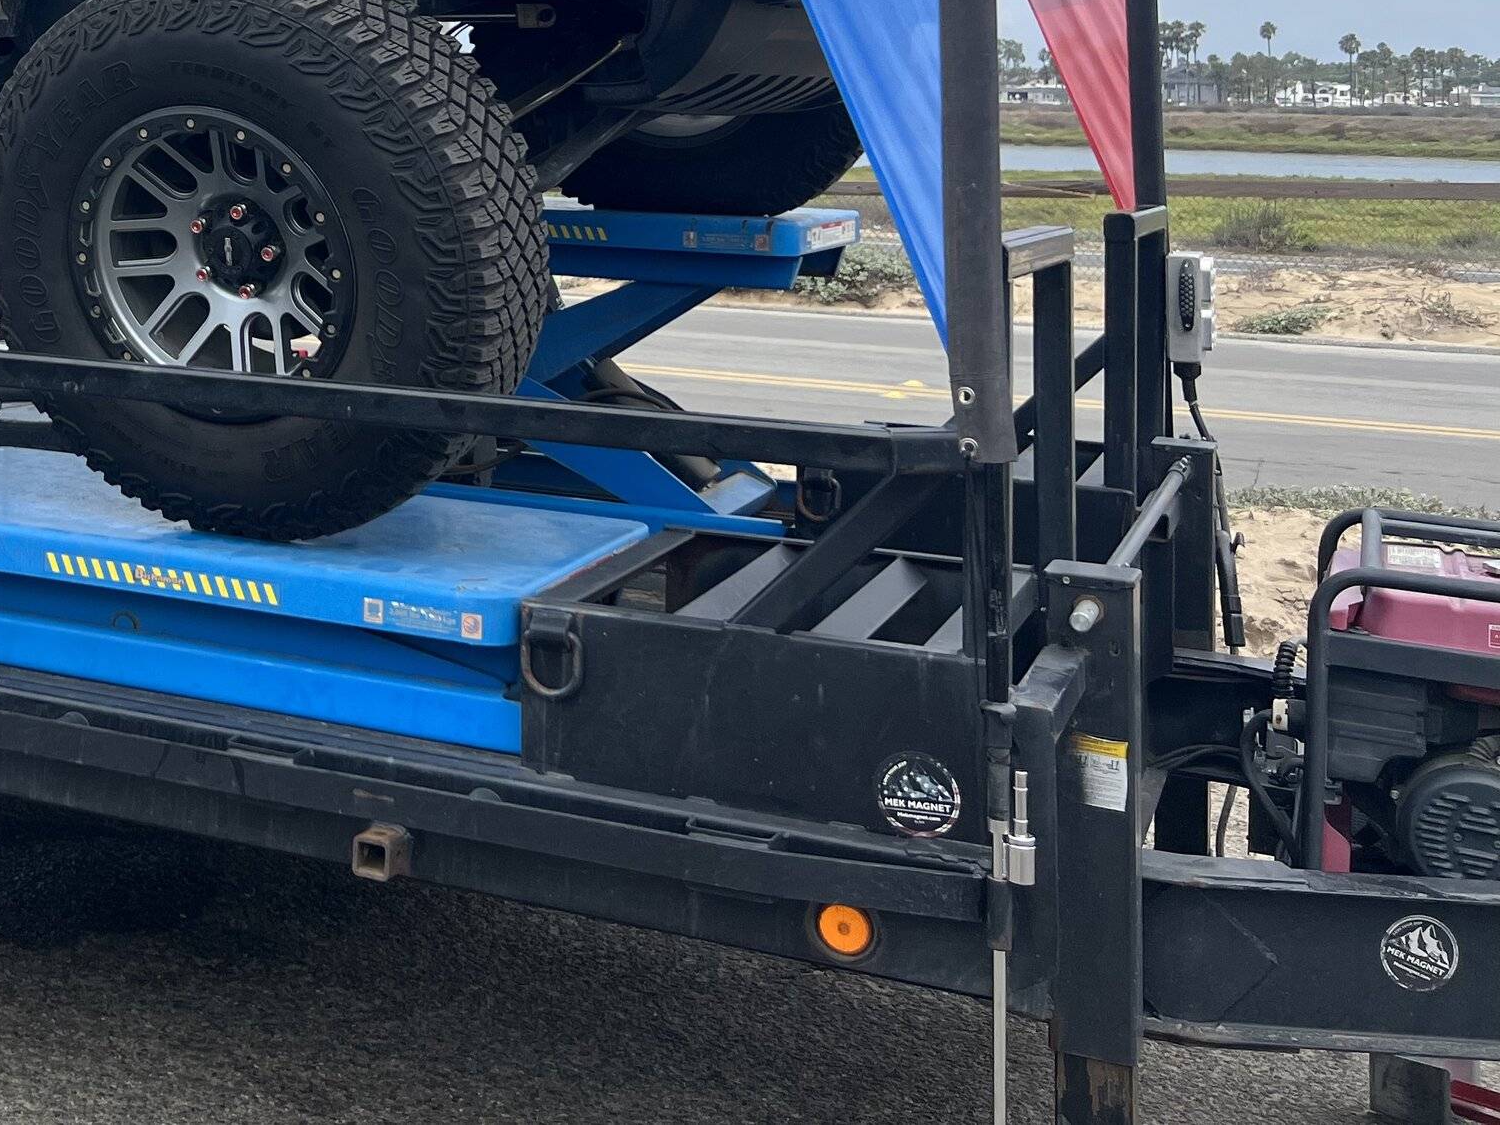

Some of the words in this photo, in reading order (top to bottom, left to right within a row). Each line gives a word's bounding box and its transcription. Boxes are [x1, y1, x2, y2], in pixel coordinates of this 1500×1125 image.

[11, 58, 136, 347] GOODYEAR
[884, 797, 906, 807] MEK
[907, 800, 952, 813] MAGNET
[1386, 945, 1406, 960] MEK
[1407, 955, 1445, 976] MAGNET
